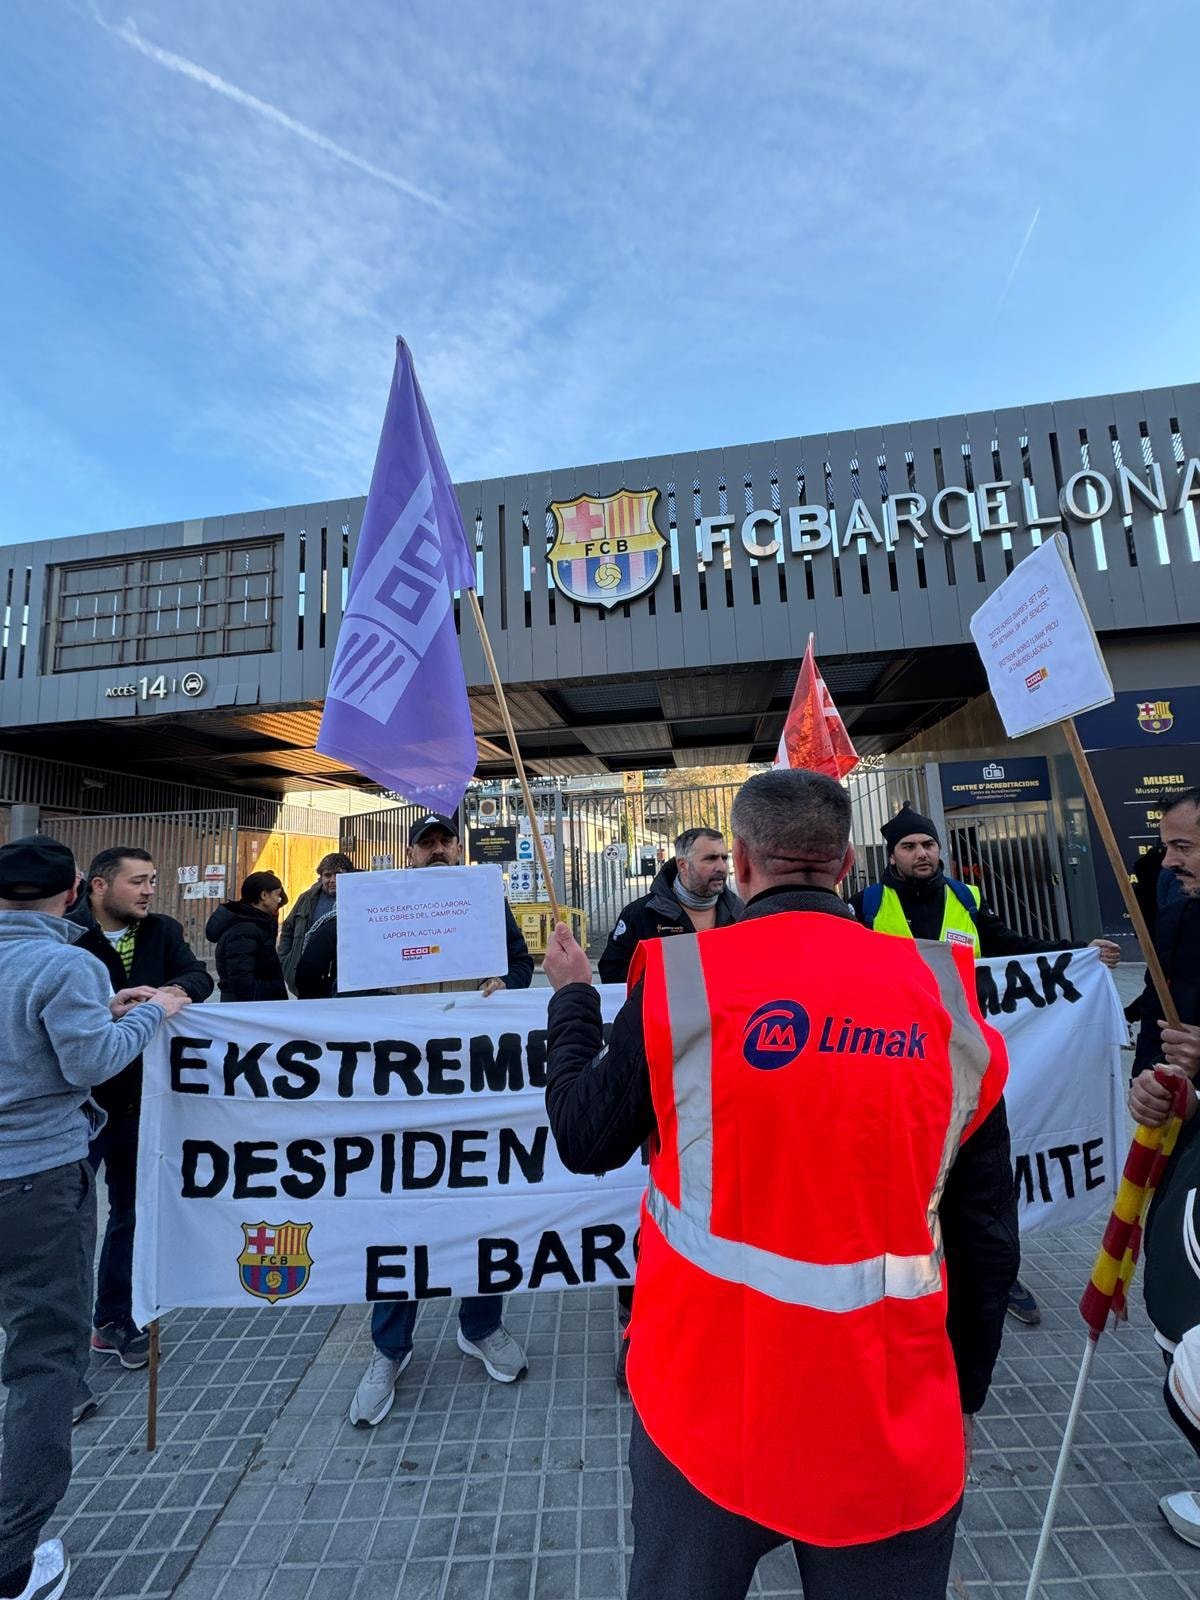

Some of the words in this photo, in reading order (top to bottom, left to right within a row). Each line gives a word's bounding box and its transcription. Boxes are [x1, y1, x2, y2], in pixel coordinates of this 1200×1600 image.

[585, 540, 628, 556] FCB
[139, 674, 167, 700] 14
[1143, 775, 1185, 786] MUSEU
[952, 783, 978, 792] CENTRE
[440, 899, 472, 908] LABORAL
[375, 915, 389, 923] LES
[390, 913, 415, 922] OBRES
[431, 910, 451, 918] CAMP
[947, 933, 967, 943] CCOO
[403, 947, 429, 956] CCOO
[818, 1015, 929, 1060] Limak
[180, 1126, 549, 1199] DESPIDEN
[260, 1255, 288, 1265] FCB
[365, 1244, 452, 1302] EL
[477, 1222, 643, 1294] BAR
